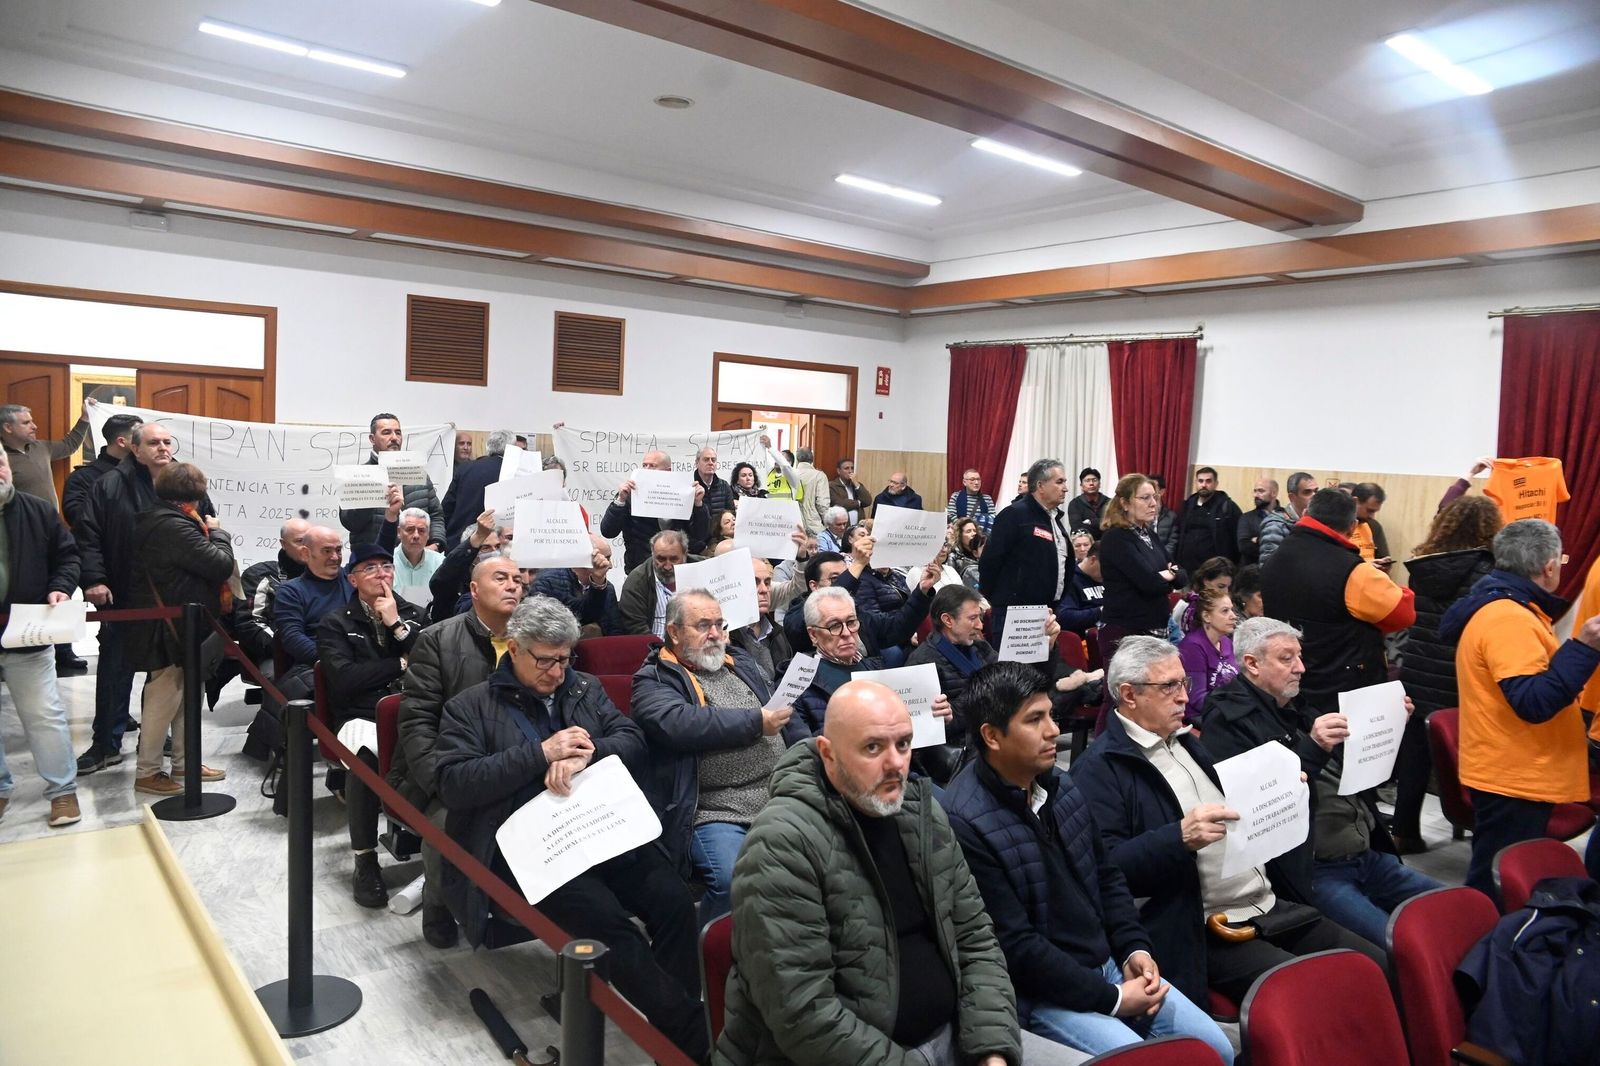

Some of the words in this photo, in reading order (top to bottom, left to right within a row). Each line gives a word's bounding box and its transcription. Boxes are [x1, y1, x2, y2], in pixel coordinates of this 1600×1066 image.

[573, 460, 590, 473] SR
[596, 460, 640, 473] BELLIDO
[1519, 488, 1546, 500] Hitachi
[259, 506, 294, 520] 2025
